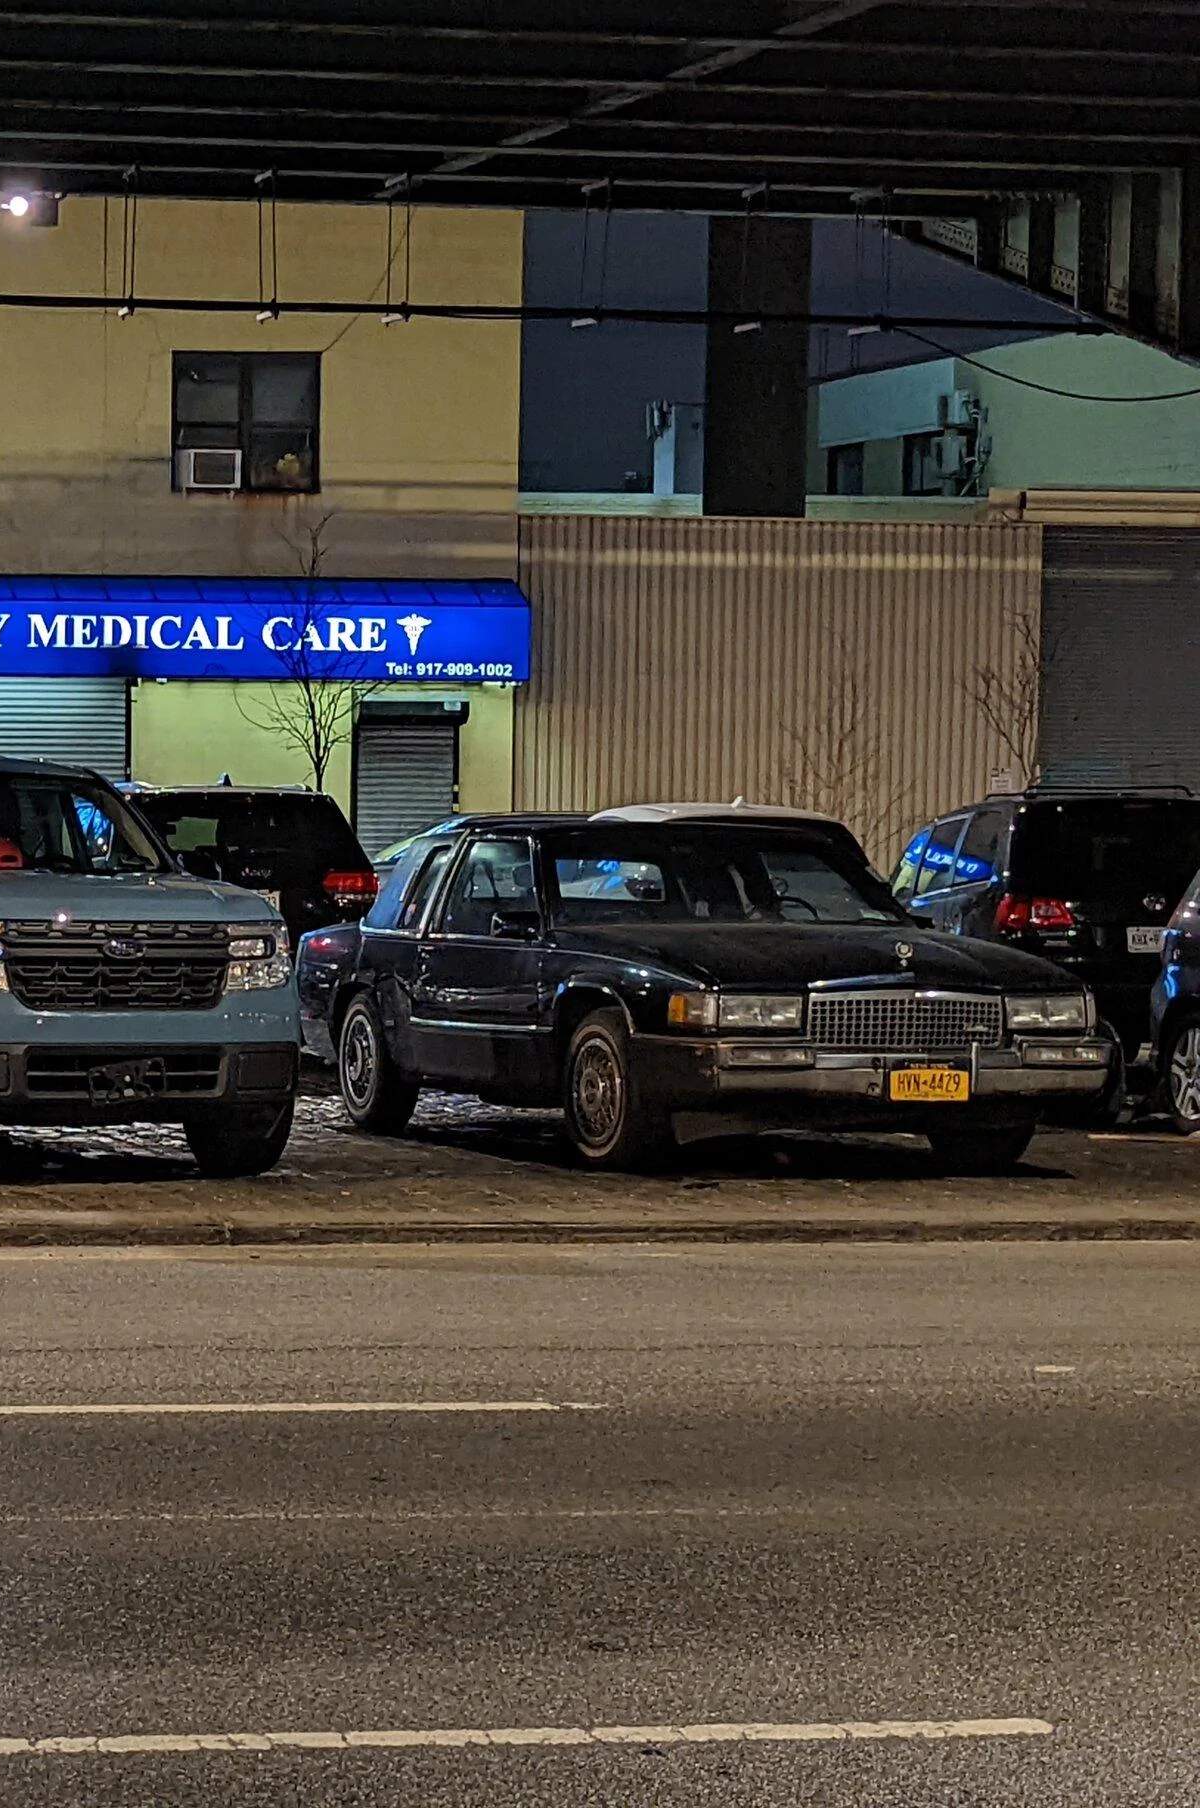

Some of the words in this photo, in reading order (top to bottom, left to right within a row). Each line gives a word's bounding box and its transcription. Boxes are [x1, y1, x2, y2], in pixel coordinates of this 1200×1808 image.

[26, 613, 244, 650] MEDICAL
[261, 616, 387, 652] CARE
[385, 661, 412, 676] Tel:
[416, 662, 513, 677] 917-909-1002
